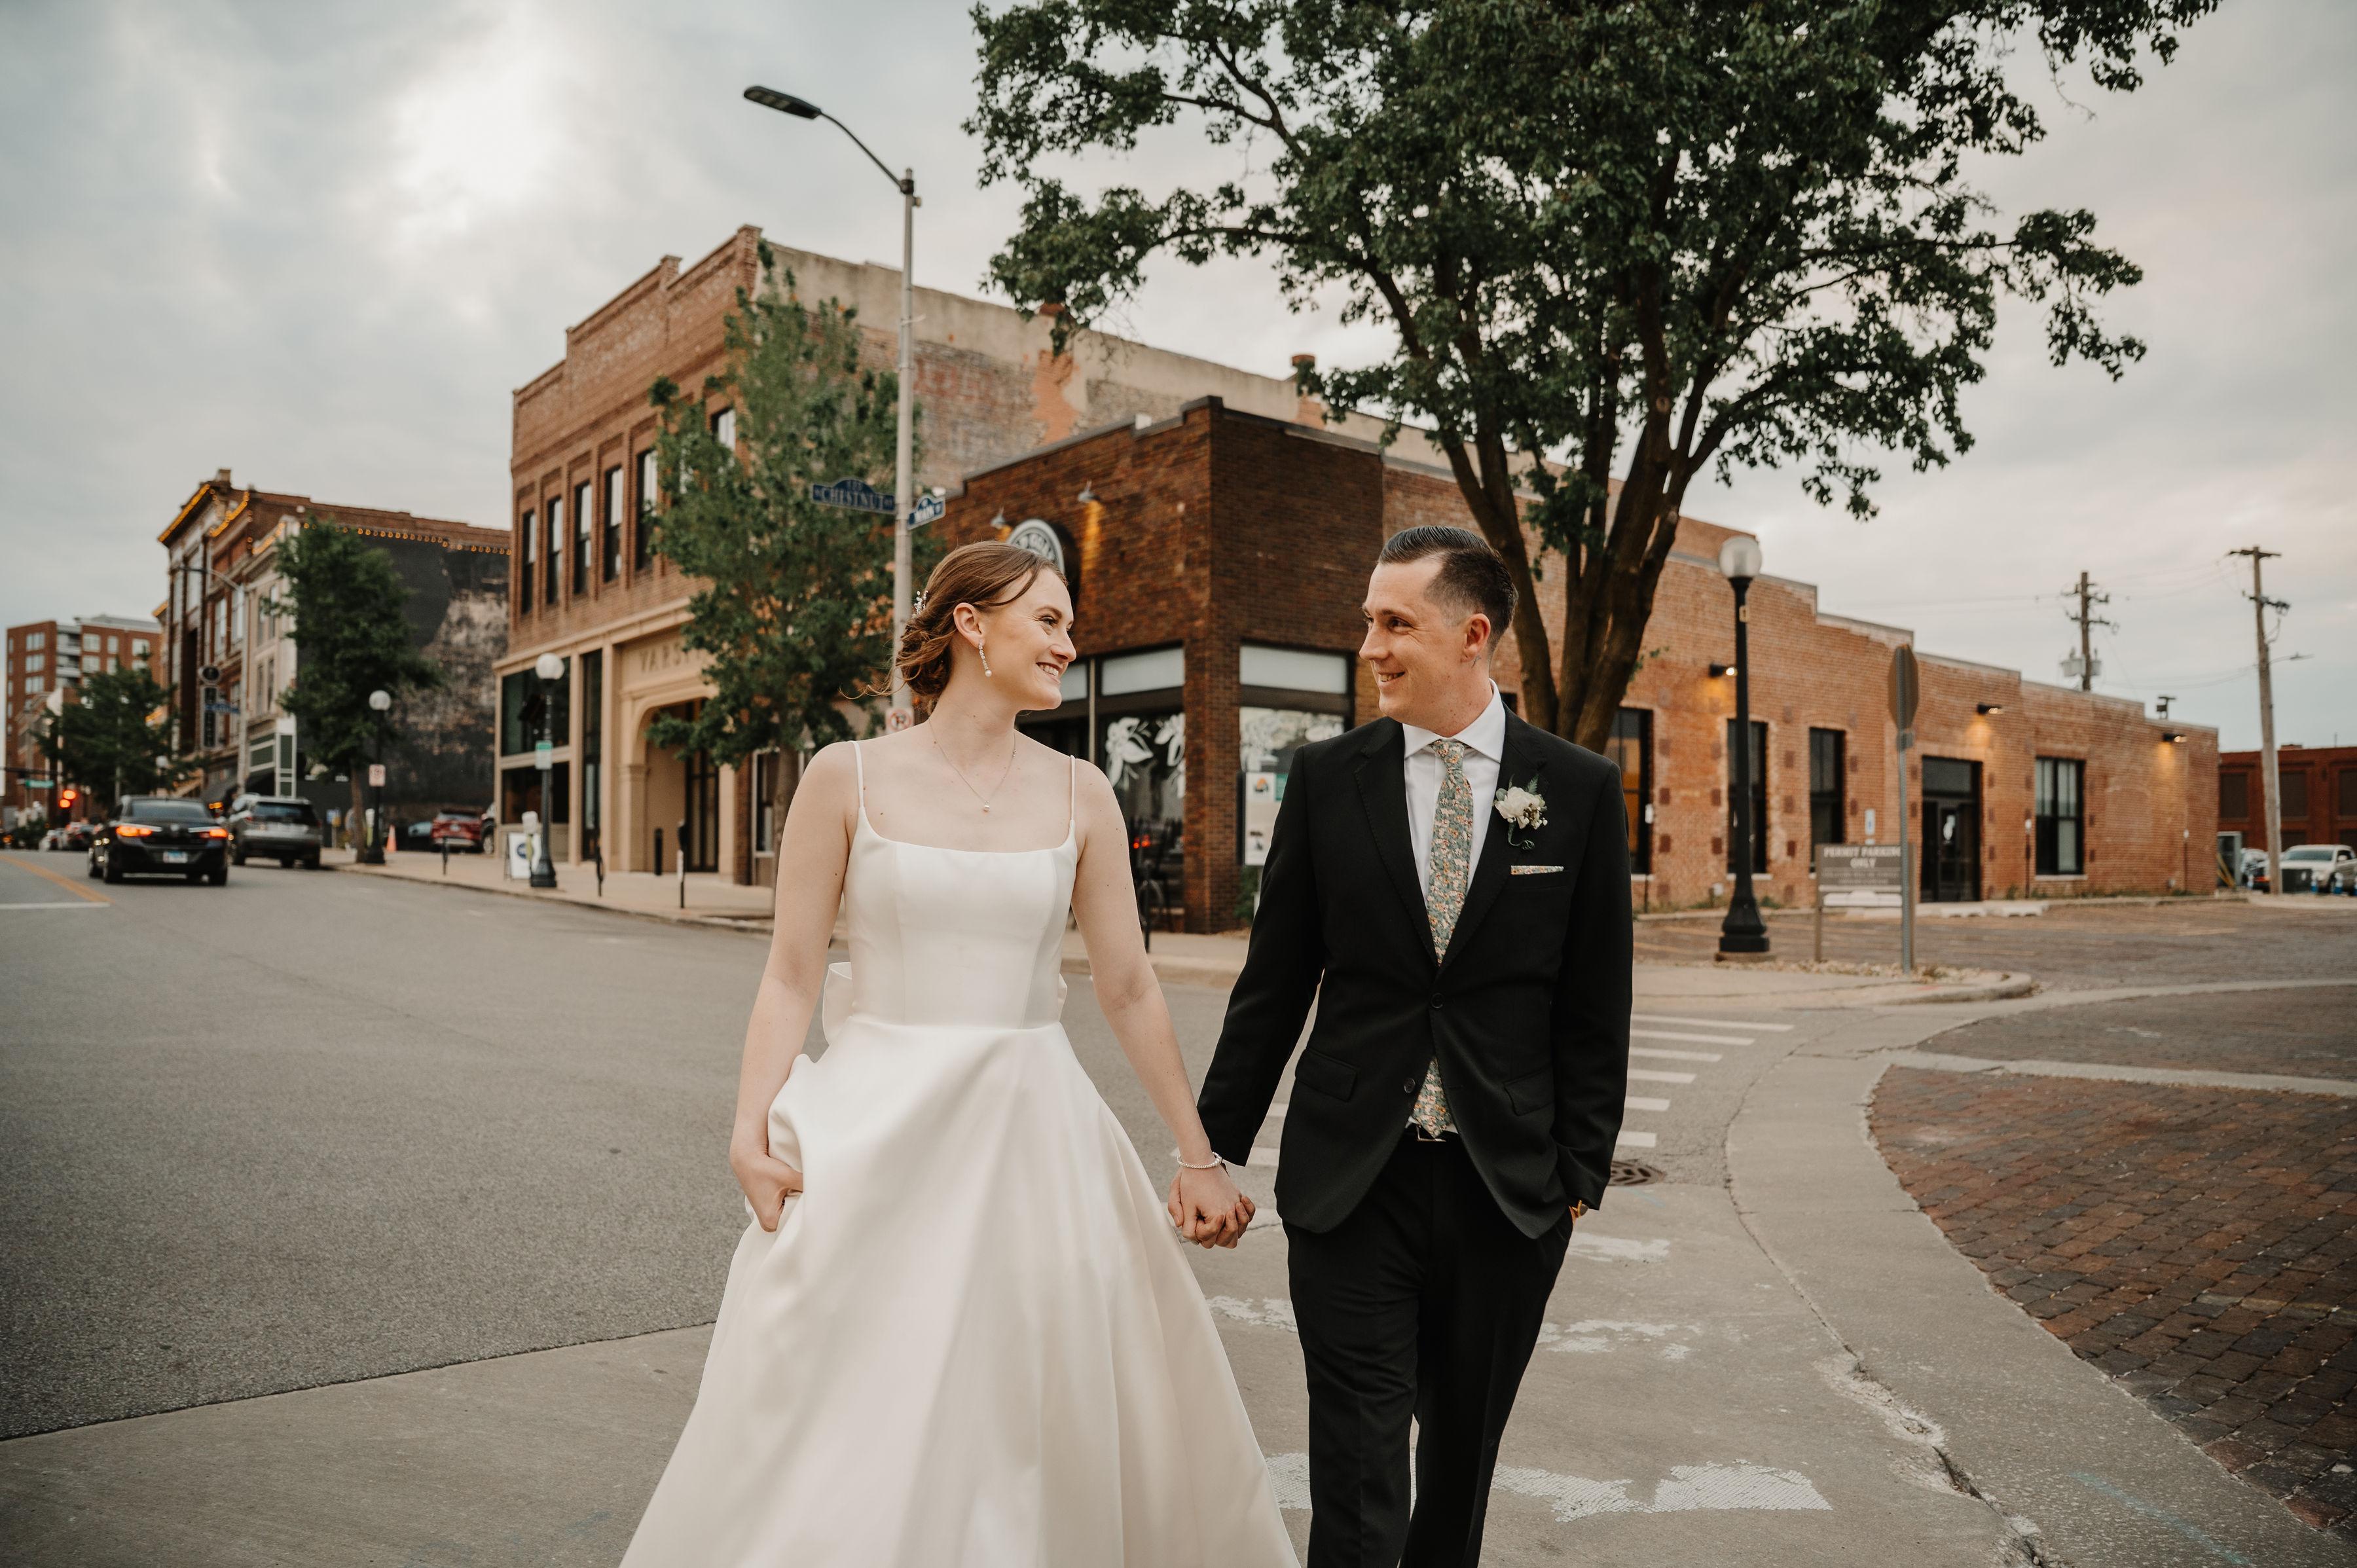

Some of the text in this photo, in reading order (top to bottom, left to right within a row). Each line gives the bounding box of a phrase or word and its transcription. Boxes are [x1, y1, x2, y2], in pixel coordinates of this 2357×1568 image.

[821, 487, 884, 510] CHESTNUT
[1823, 846, 1859, 858] PERMIT
[1850, 858, 1876, 868] ONLY
